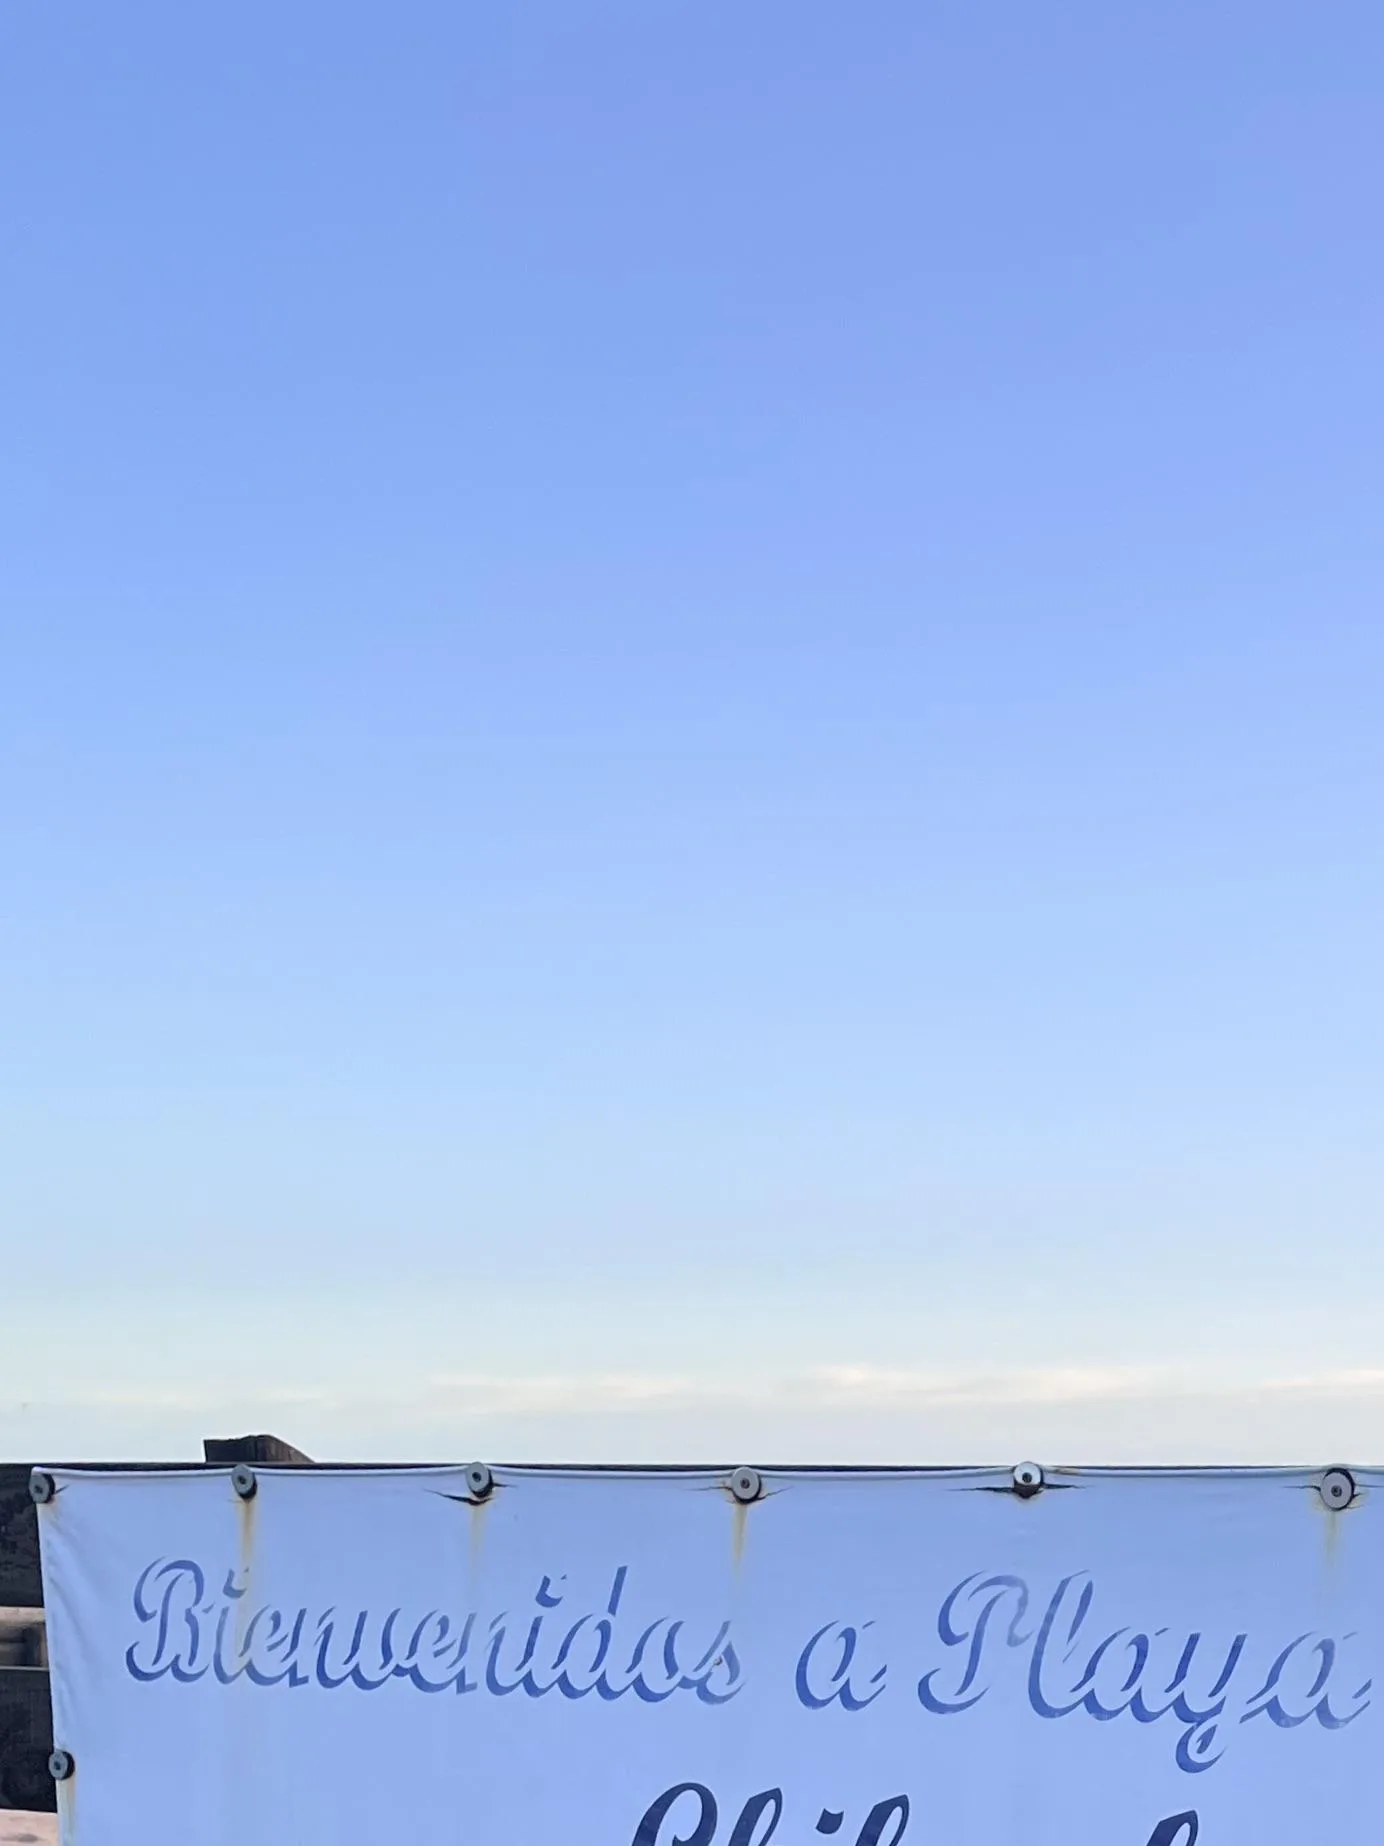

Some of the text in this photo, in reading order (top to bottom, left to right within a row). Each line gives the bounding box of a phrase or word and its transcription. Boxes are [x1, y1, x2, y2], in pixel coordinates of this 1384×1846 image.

[126, 1557, 745, 1706] Bienvenidos
[794, 1617, 887, 1712] a
[918, 1569, 1374, 1774] Playa
